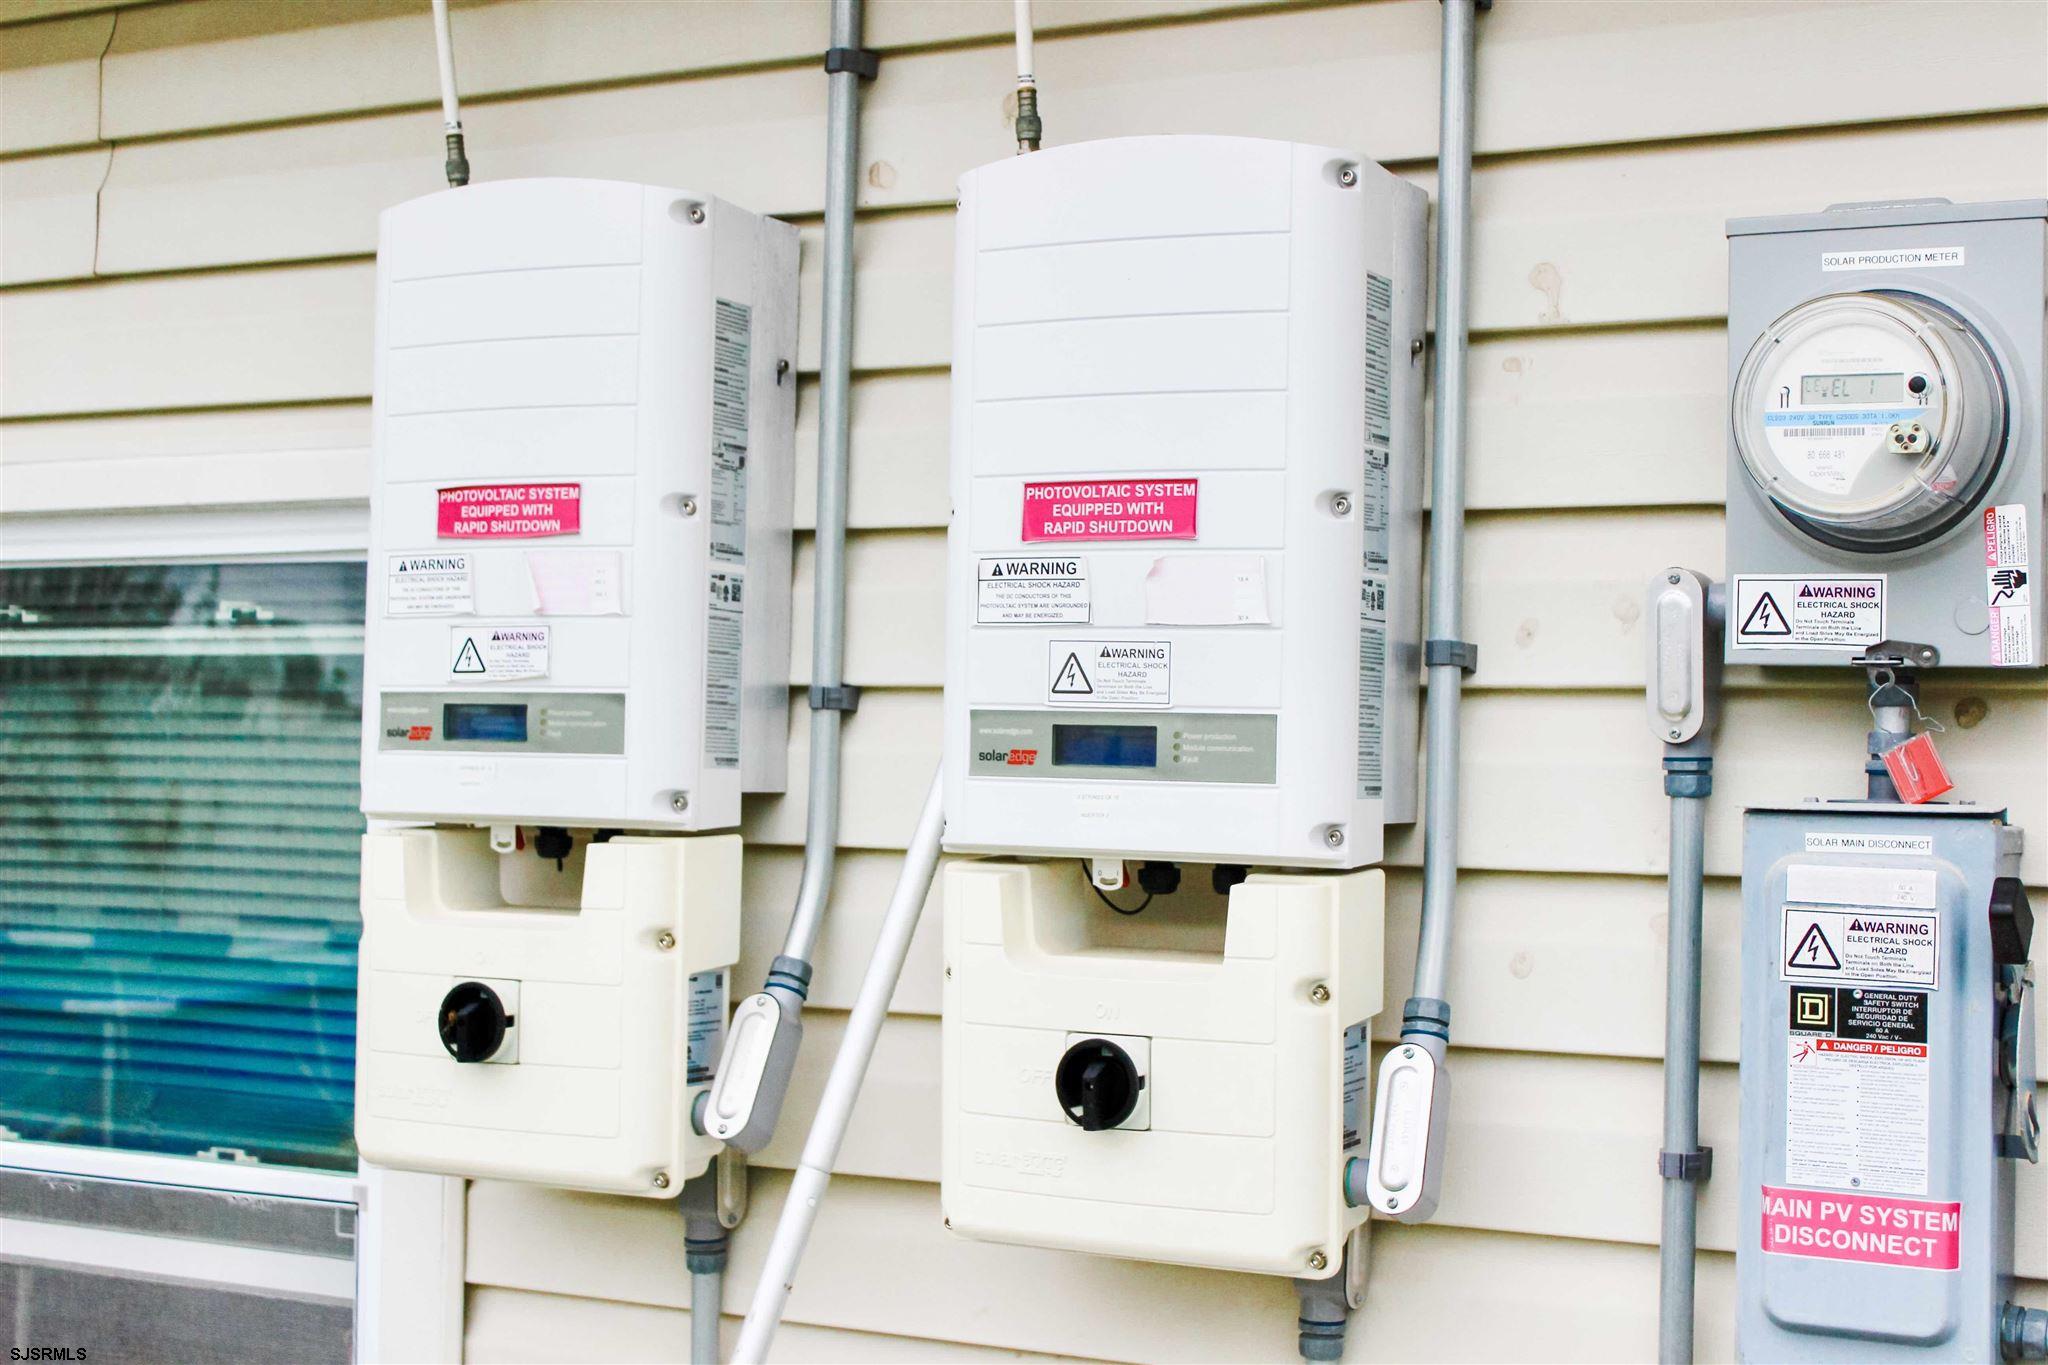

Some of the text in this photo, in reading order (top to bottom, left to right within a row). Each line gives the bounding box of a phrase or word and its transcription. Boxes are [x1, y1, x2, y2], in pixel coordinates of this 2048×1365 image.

[1824, 251, 1958, 267] SOLAR PRODUCTION METER
[440, 486, 580, 504] PHOTOVOLTAIC SYSTEM
[1026, 483, 1196, 501] PHOTOVOLTAIC SYSTEM
[461, 504, 554, 518] EQUIPPED WITH
[1052, 502, 1165, 517] EQUIPPED WITH
[454, 519, 560, 534] RAPID SHUTDOWN
[1044, 520, 1174, 535] RAPID SHUTDOWN
[1986, 512, 1996, 552] PELIGRO
[410, 558, 465, 571] WARNING
[1006, 562, 1077, 576] WARNING
[1812, 586, 1876, 599] WARNING
[1820, 611, 1856, 619] HAZARD
[500, 632, 544, 641] WARNING
[1990, 612, 2000, 651] DANGER
[1112, 648, 1165, 659] WARNING
[979, 749, 1037, 765] solaredge
[1806, 838, 1930, 850] SOLAR MAIN DISCONNECT
[1864, 921, 1929, 936] WARNING
[1846, 935, 1933, 946] ELECTRICAL SHOCK
[1872, 946, 1908, 956] HAZARD
[1864, 992, 1897, 1000] GENERAL
[1852, 1006, 1902, 1014] INTERRUPTOR
[1856, 1012, 1897, 1020] SEGURIDAD
[1833, 1042, 1872, 1052] DANGER
[1880, 1044, 1922, 1055] PELIGRO
[1762, 1195, 1958, 1232] MAIN PV SYSTEM
[1774, 1224, 1937, 1258] DISCONNECT
